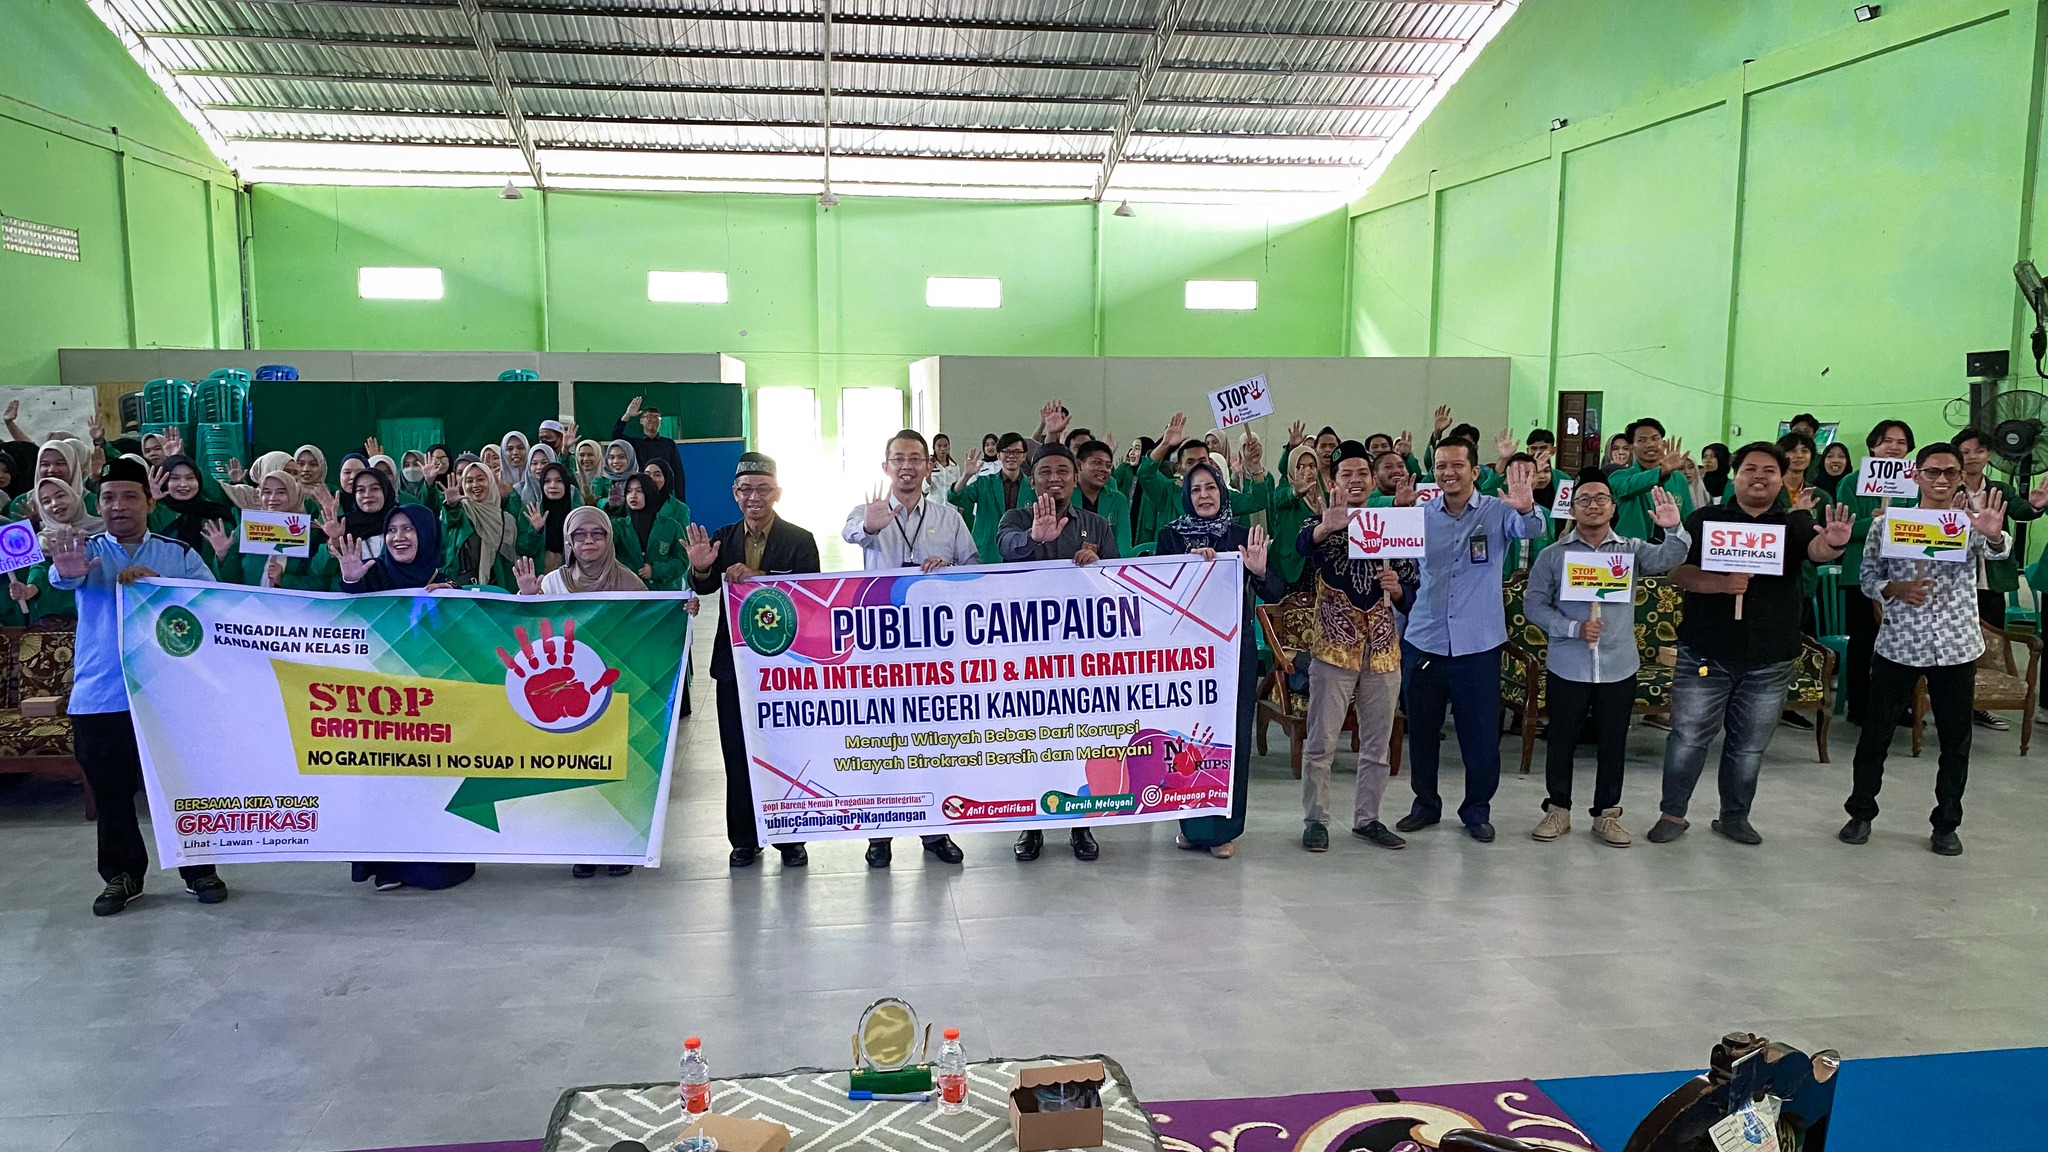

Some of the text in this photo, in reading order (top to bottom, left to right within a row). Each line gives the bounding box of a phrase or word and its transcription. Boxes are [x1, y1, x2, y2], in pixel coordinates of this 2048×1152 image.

[1217, 386, 1248, 411] STOP
[1222, 410, 1240, 427] No
[1868, 460, 1904, 479] STOP
[1420, 488, 1441, 501] ST
[1864, 479, 1882, 493] No
[1895, 524, 1923, 532] STOP
[1362, 537, 1424, 549] STOP PUNGLI
[1710, 530, 1776, 548] STP
[1710, 548, 1776, 559] GRATIFIKASI
[1572, 567, 1596, 575] STOP
[214, 623, 365, 639] PENGADILAN NEGERI
[834, 604, 954, 652] PUBLIC
[964, 596, 1142, 646] CAMPAIGN
[214, 635, 369, 655] KANDANGAN KELAS IB
[759, 645, 1215, 691] ZONA INTEGRITAS (ZI) & ANTI GRATIFIKASI
[309, 682, 434, 717] STOP
[757, 678, 1218, 729] PENGADILAN NEGERI KANDANGAN KELAS IB
[310, 717, 451, 743] GRATIFIKASI
[845, 719, 1140, 751] Menuju Wilayah Bebas Dari Korupsi
[308, 750, 333, 766] NO
[335, 751, 431, 768] GRATIFIKASI
[447, 754, 472, 768] NO
[474, 755, 514, 769] SUAP
[530, 755, 555, 769] NO
[557, 755, 612, 770] PUNGLI
[834, 741, 1152, 774] Wilayah Birokrasi Bersih dan Melayani
[1167, 760, 1231, 773] KRUPS
[175, 795, 319, 811] BERSAMA KITA TOLAK
[763, 801, 778, 811] gopi
[781, 801, 806, 810] Bareng
[808, 799, 833, 808] Menuju
[835, 798, 875, 807] Pengadilan
[1065, 797, 1133, 811] Bersih Melayani
[1164, 791, 1206, 803] Pelayanan
[967, 803, 1033, 816] Anti Gratifikasi
[176, 811, 317, 834] GRATIFIKASI
[765, 811, 926, 829] ublicCampaignPNKandangan
[184, 840, 210, 849] Lihat
[220, 838, 253, 847] Lawan
[262, 837, 309, 847] Laporkan
